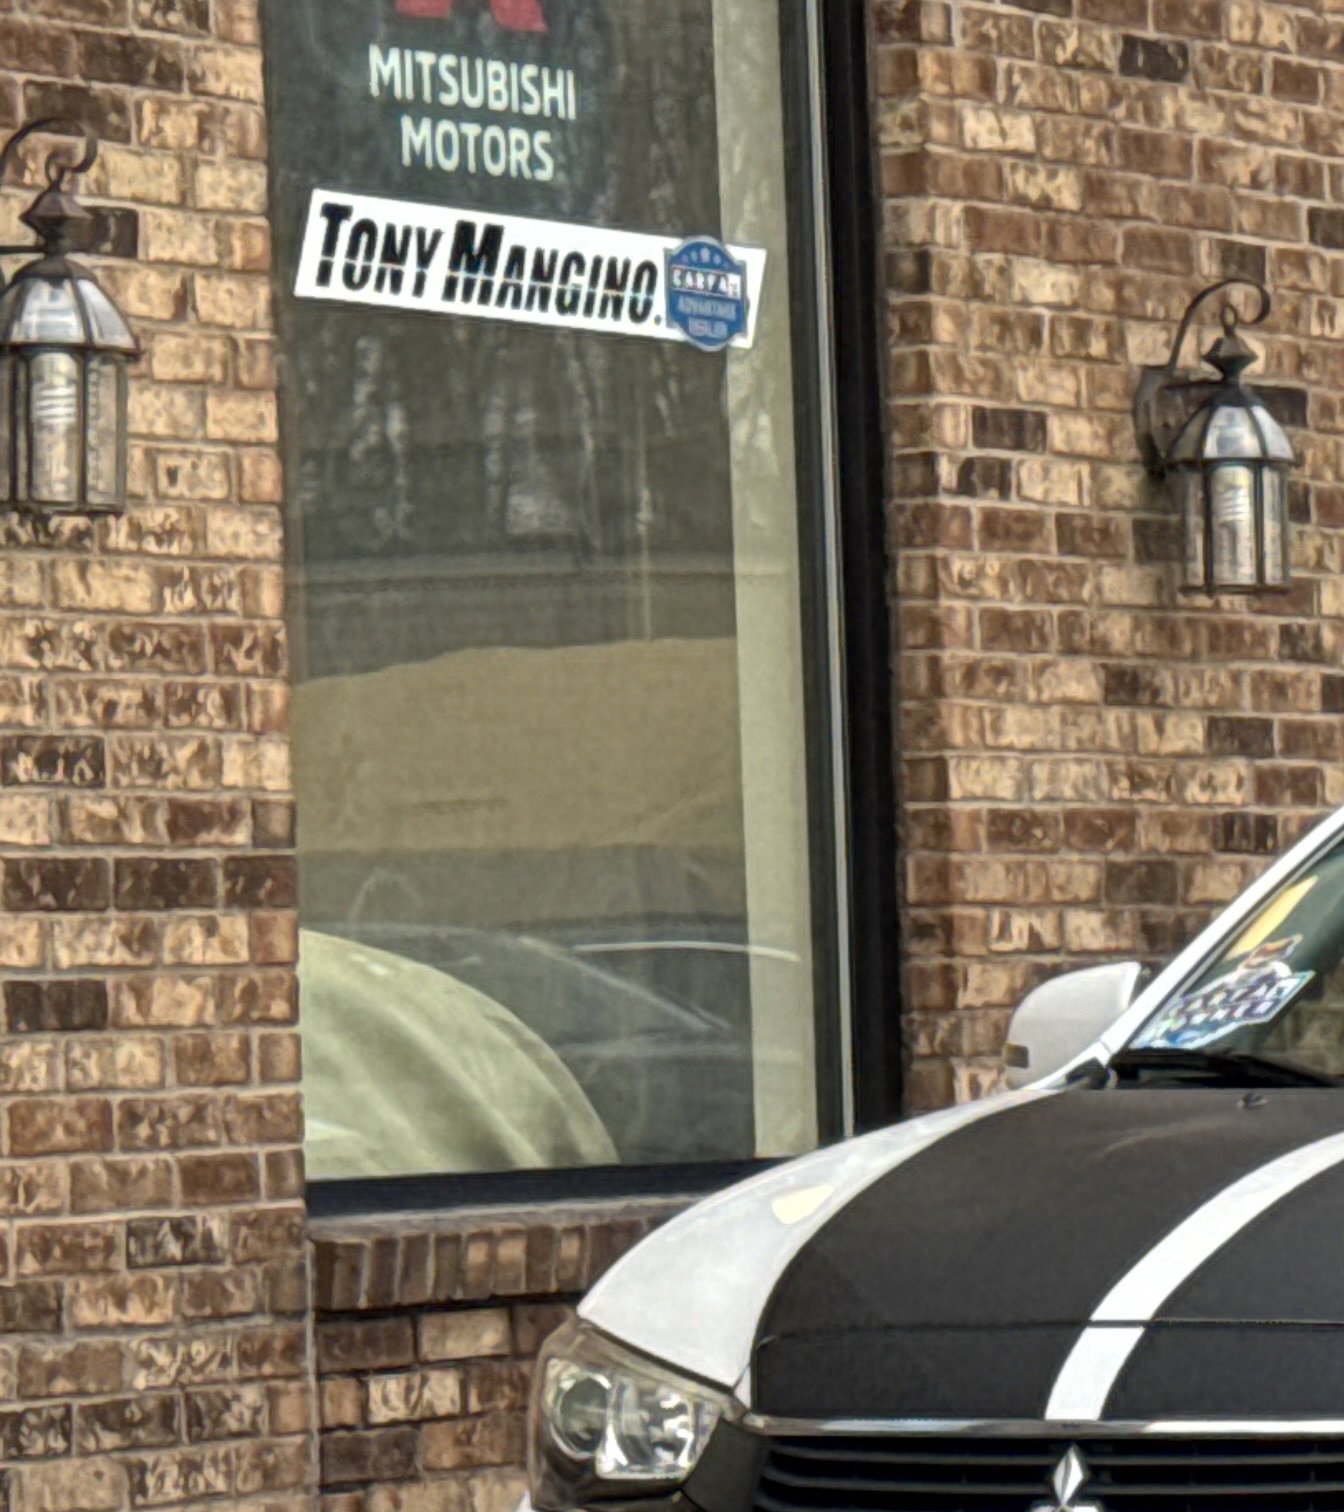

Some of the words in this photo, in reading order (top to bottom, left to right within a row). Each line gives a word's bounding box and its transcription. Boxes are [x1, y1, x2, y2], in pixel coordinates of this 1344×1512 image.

[368, 43, 577, 121] MITSUBISHI
[400, 114, 554, 182] MOTORS
[314, 202, 444, 299] TONY
